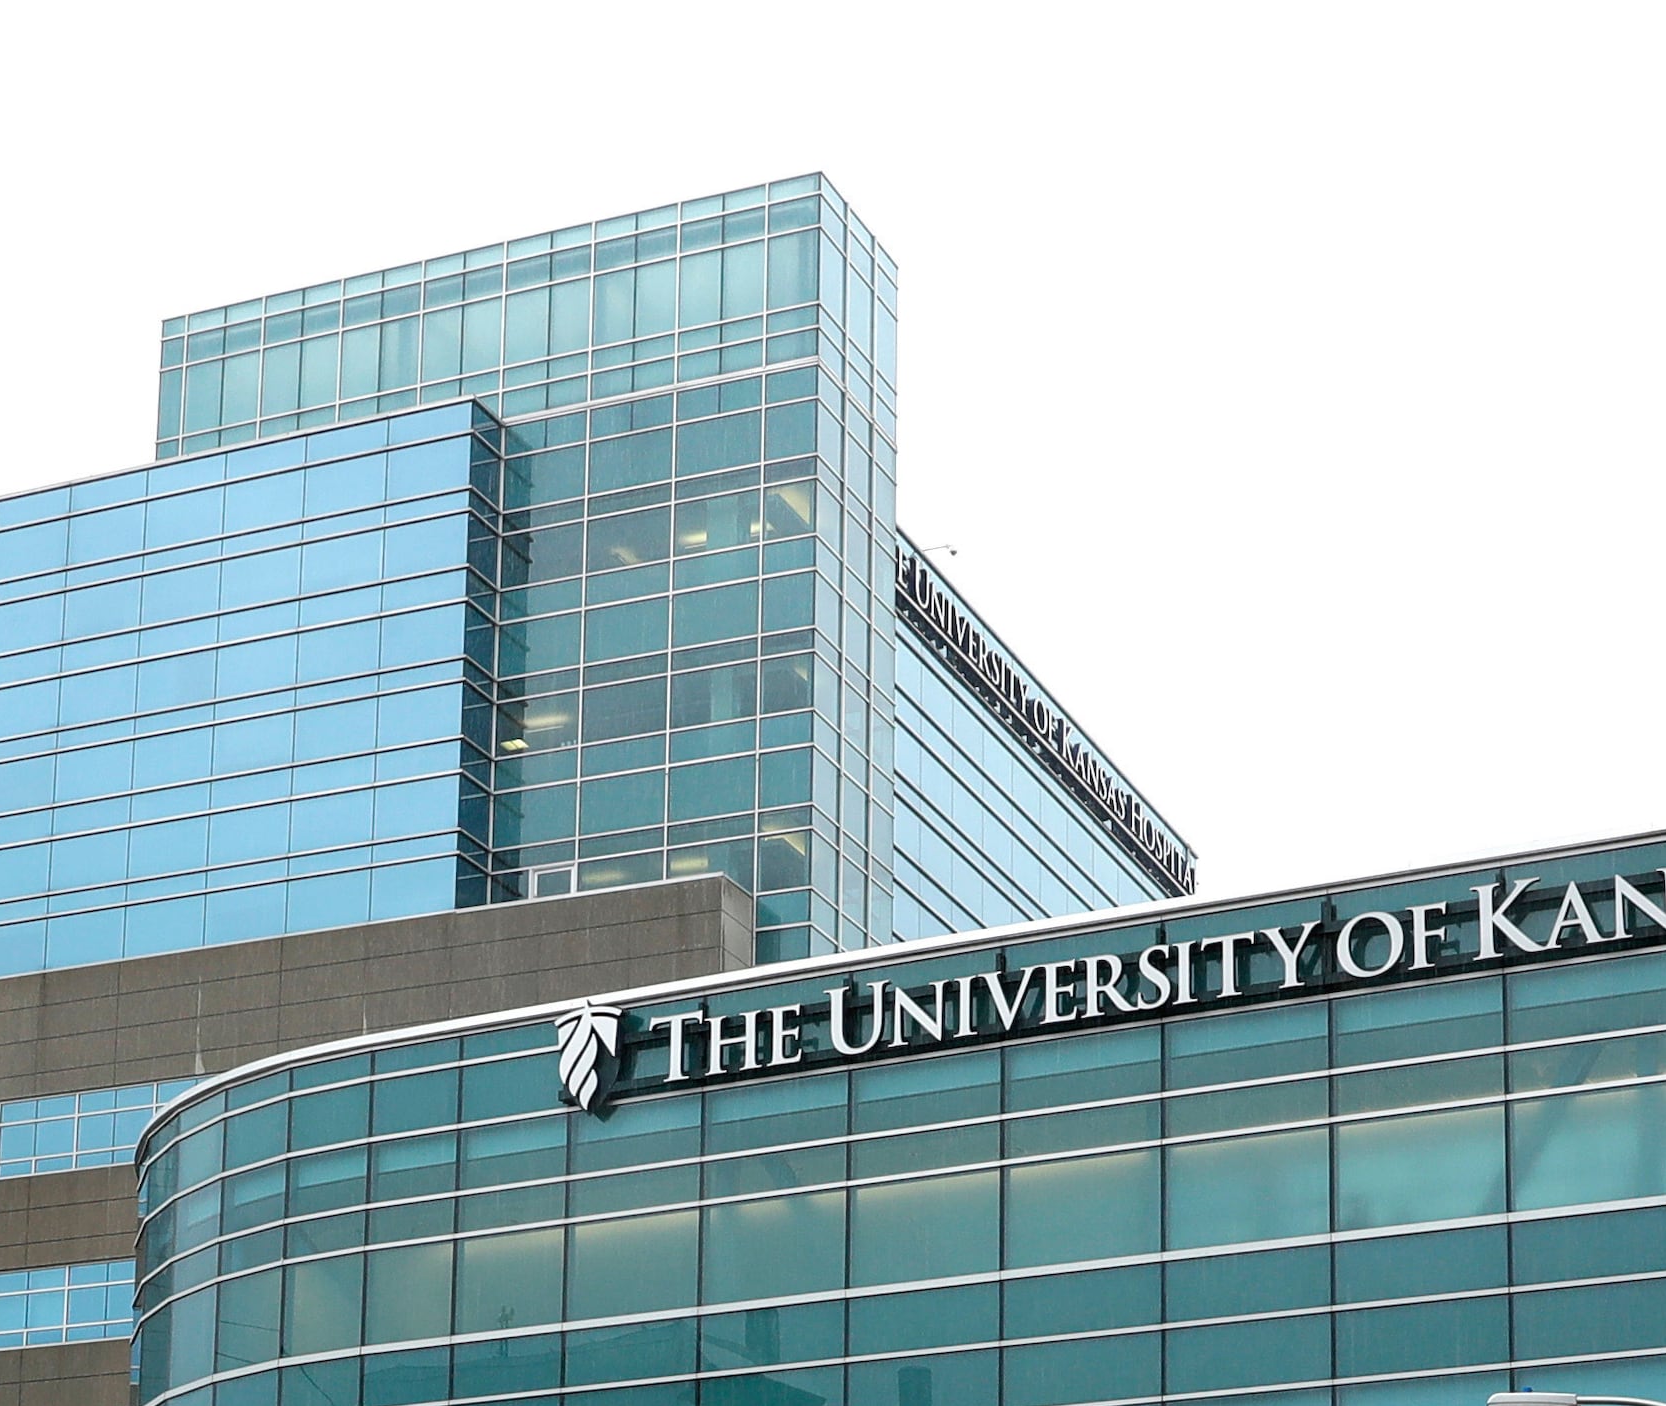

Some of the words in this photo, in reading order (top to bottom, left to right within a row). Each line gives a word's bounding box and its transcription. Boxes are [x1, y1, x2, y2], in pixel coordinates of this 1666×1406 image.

[914, 557, 1030, 718] UNIVERSITY
[1033, 698, 1059, 743] OF
[1062, 719, 1128, 820] KANSAS
[1131, 799, 1196, 893] HOSPITA
[650, 1002, 802, 1083] THE
[824, 920, 1321, 1056] UNIVERSITY
[1336, 902, 1448, 978] OF
